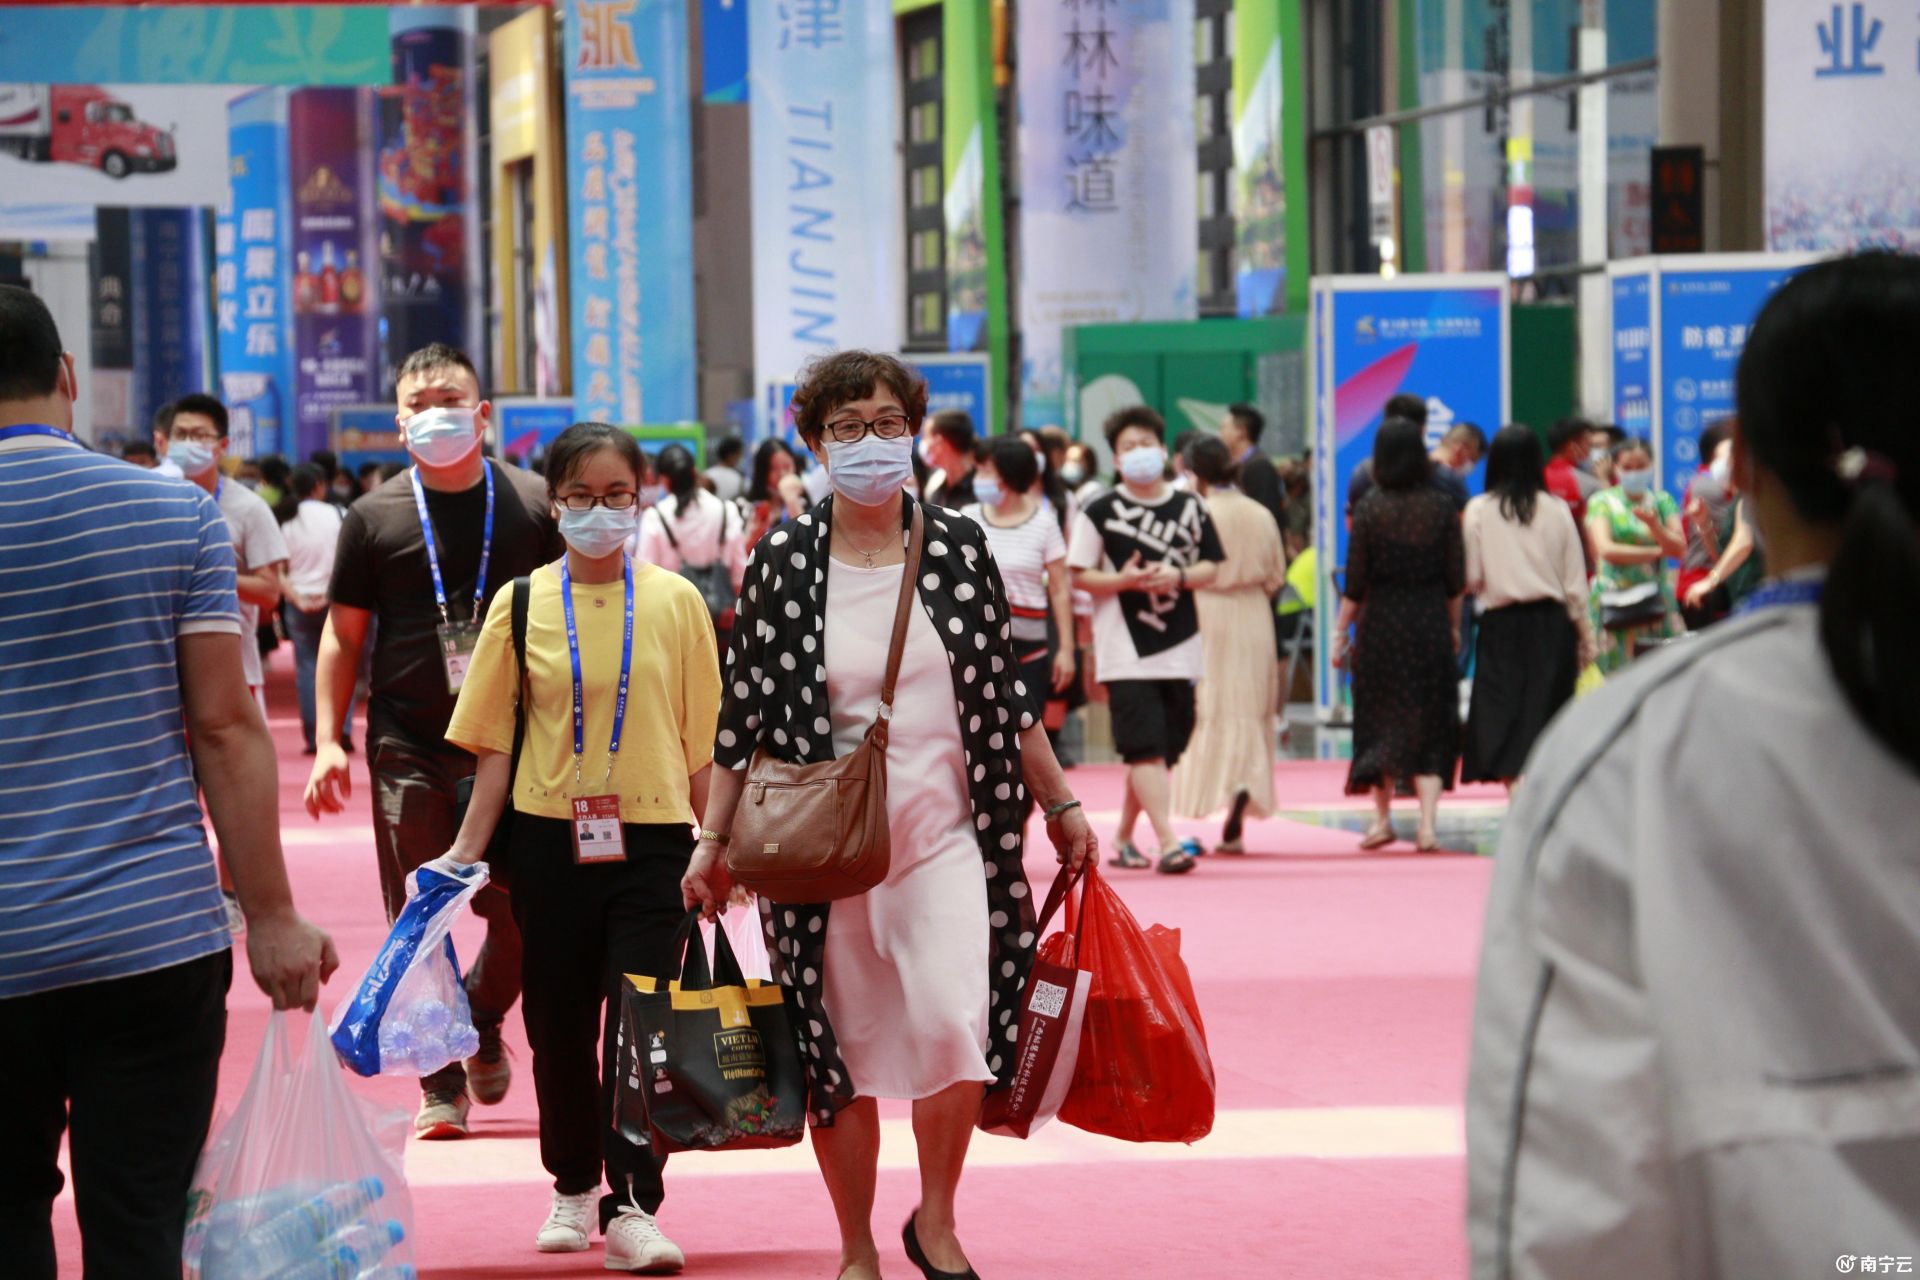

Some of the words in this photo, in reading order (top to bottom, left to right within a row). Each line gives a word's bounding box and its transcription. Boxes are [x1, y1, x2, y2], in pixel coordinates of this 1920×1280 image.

[1062, 0, 1120, 214] 林味道
[788, 101, 836, 348] TIANJIN
[574, 800, 589, 813] 18
